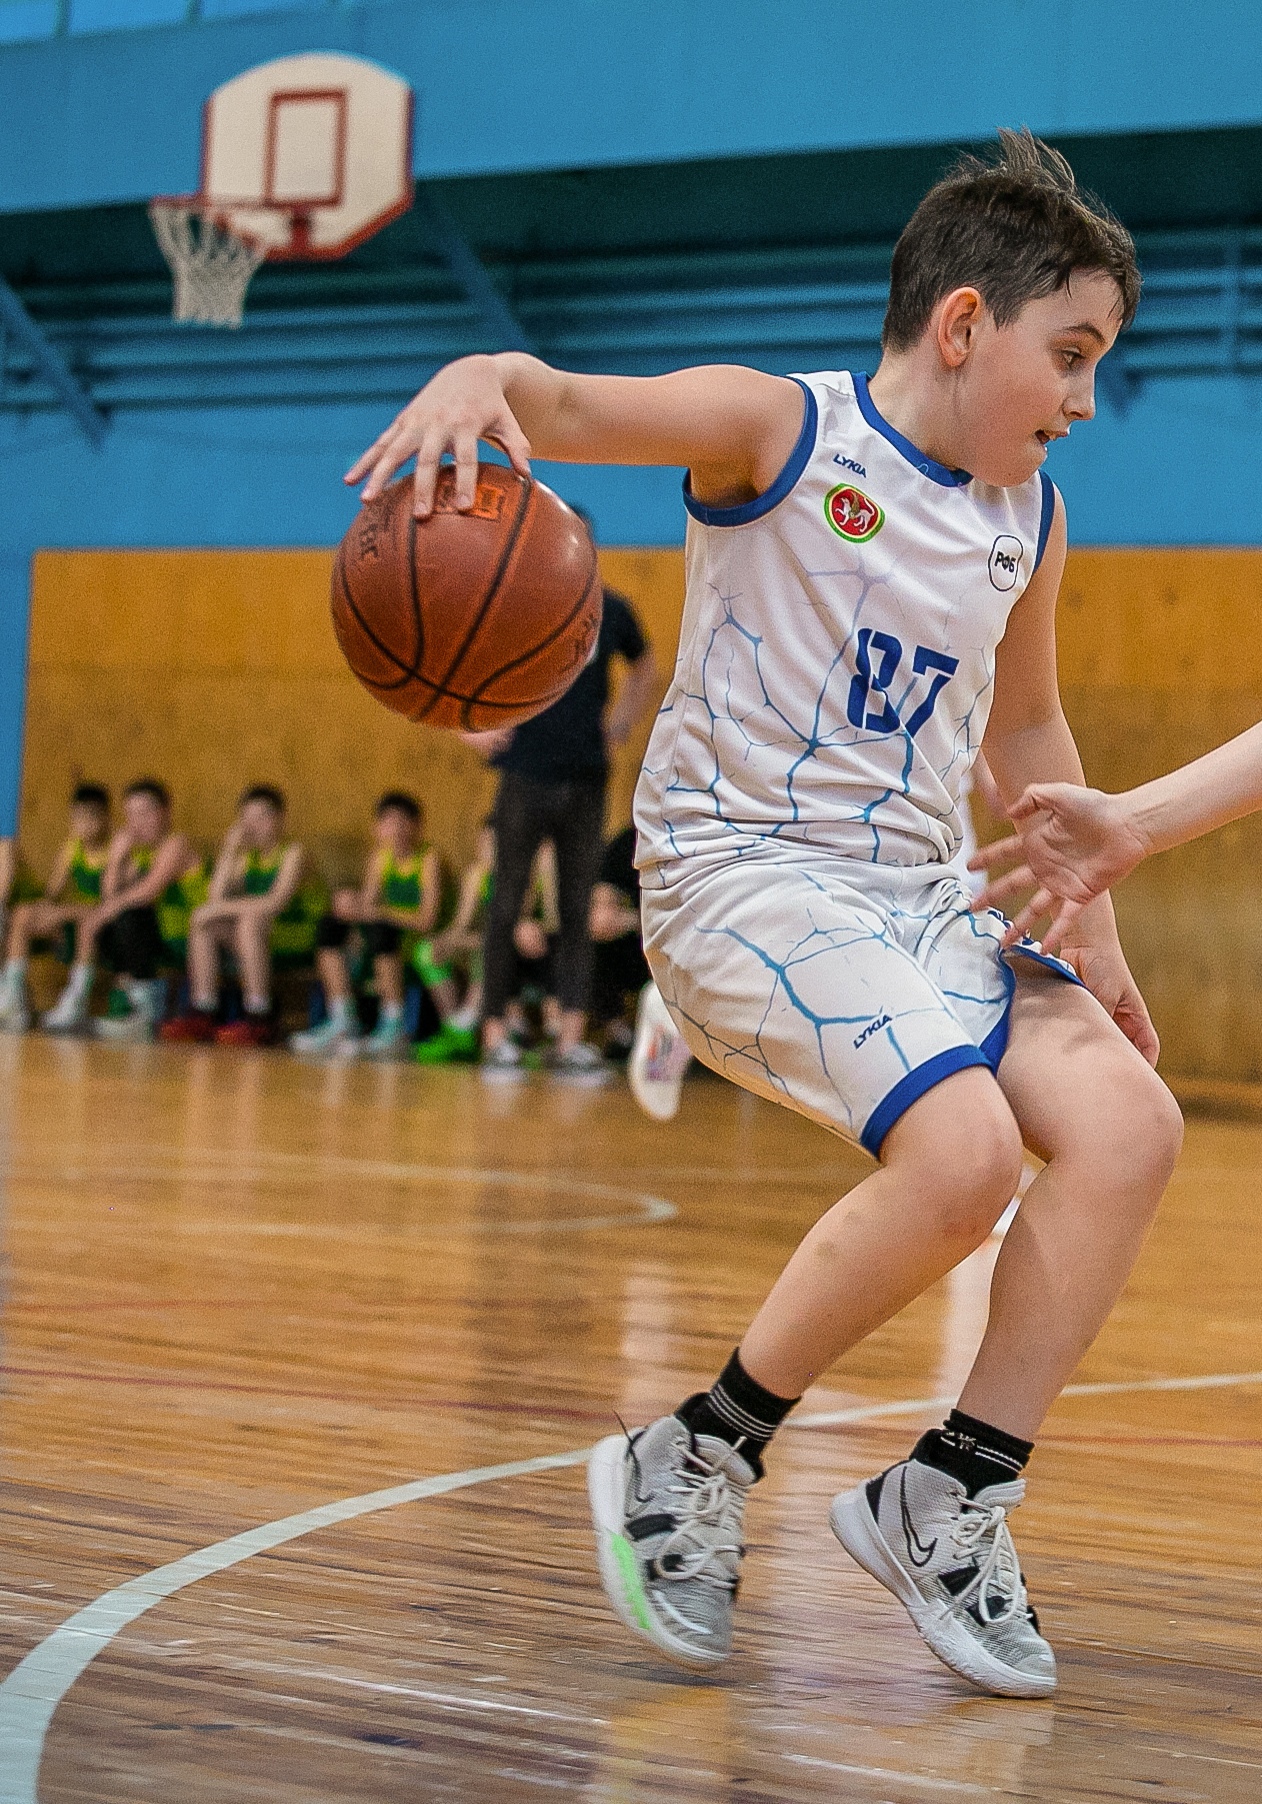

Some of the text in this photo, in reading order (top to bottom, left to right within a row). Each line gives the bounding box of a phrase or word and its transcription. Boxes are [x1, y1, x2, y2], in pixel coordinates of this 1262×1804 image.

[832, 453, 867, 479] LYKIA
[994, 550, 1016, 573] РФБ
[846, 627, 960, 739] 87
[853, 1014, 893, 1050] LYKIA
